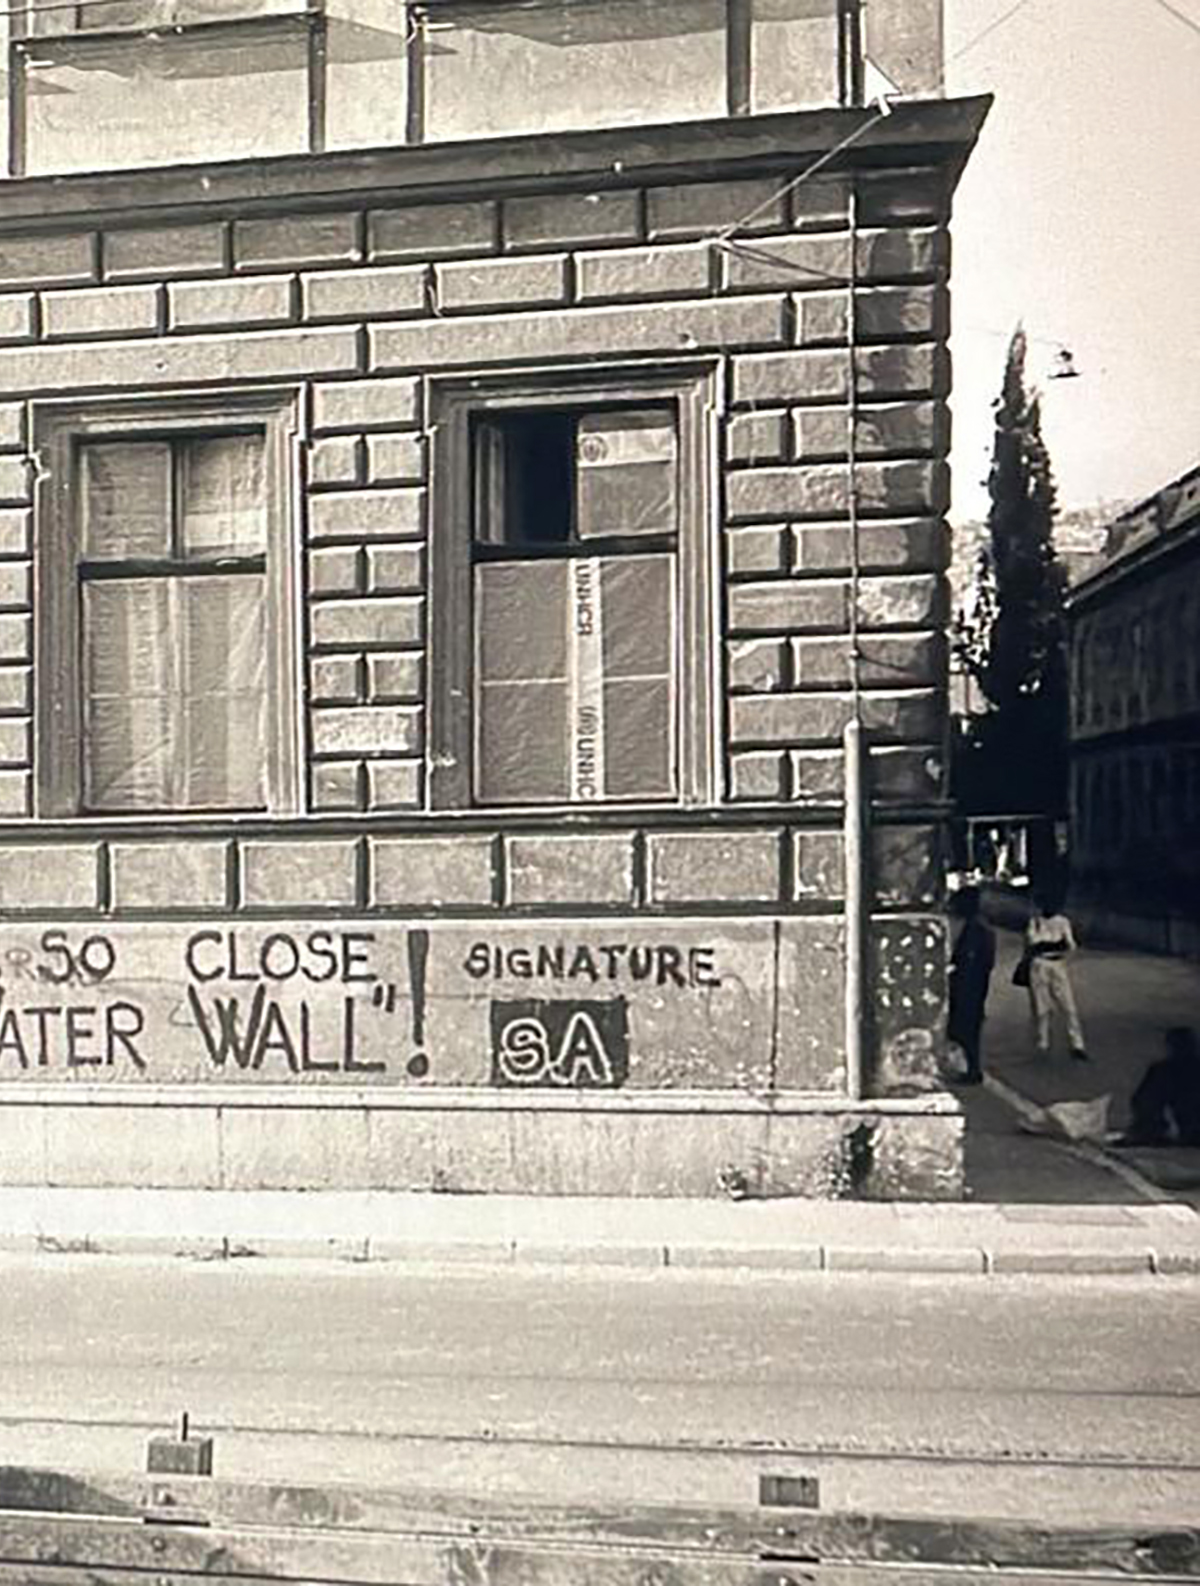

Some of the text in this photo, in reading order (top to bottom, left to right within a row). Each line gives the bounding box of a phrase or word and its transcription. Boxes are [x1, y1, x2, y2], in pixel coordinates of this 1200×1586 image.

[36, 929, 116, 984] SO
[184, 929, 379, 983] CLOSE
[463, 942, 722, 989] SIGNATURE
[499, 1010, 614, 1085] SA
